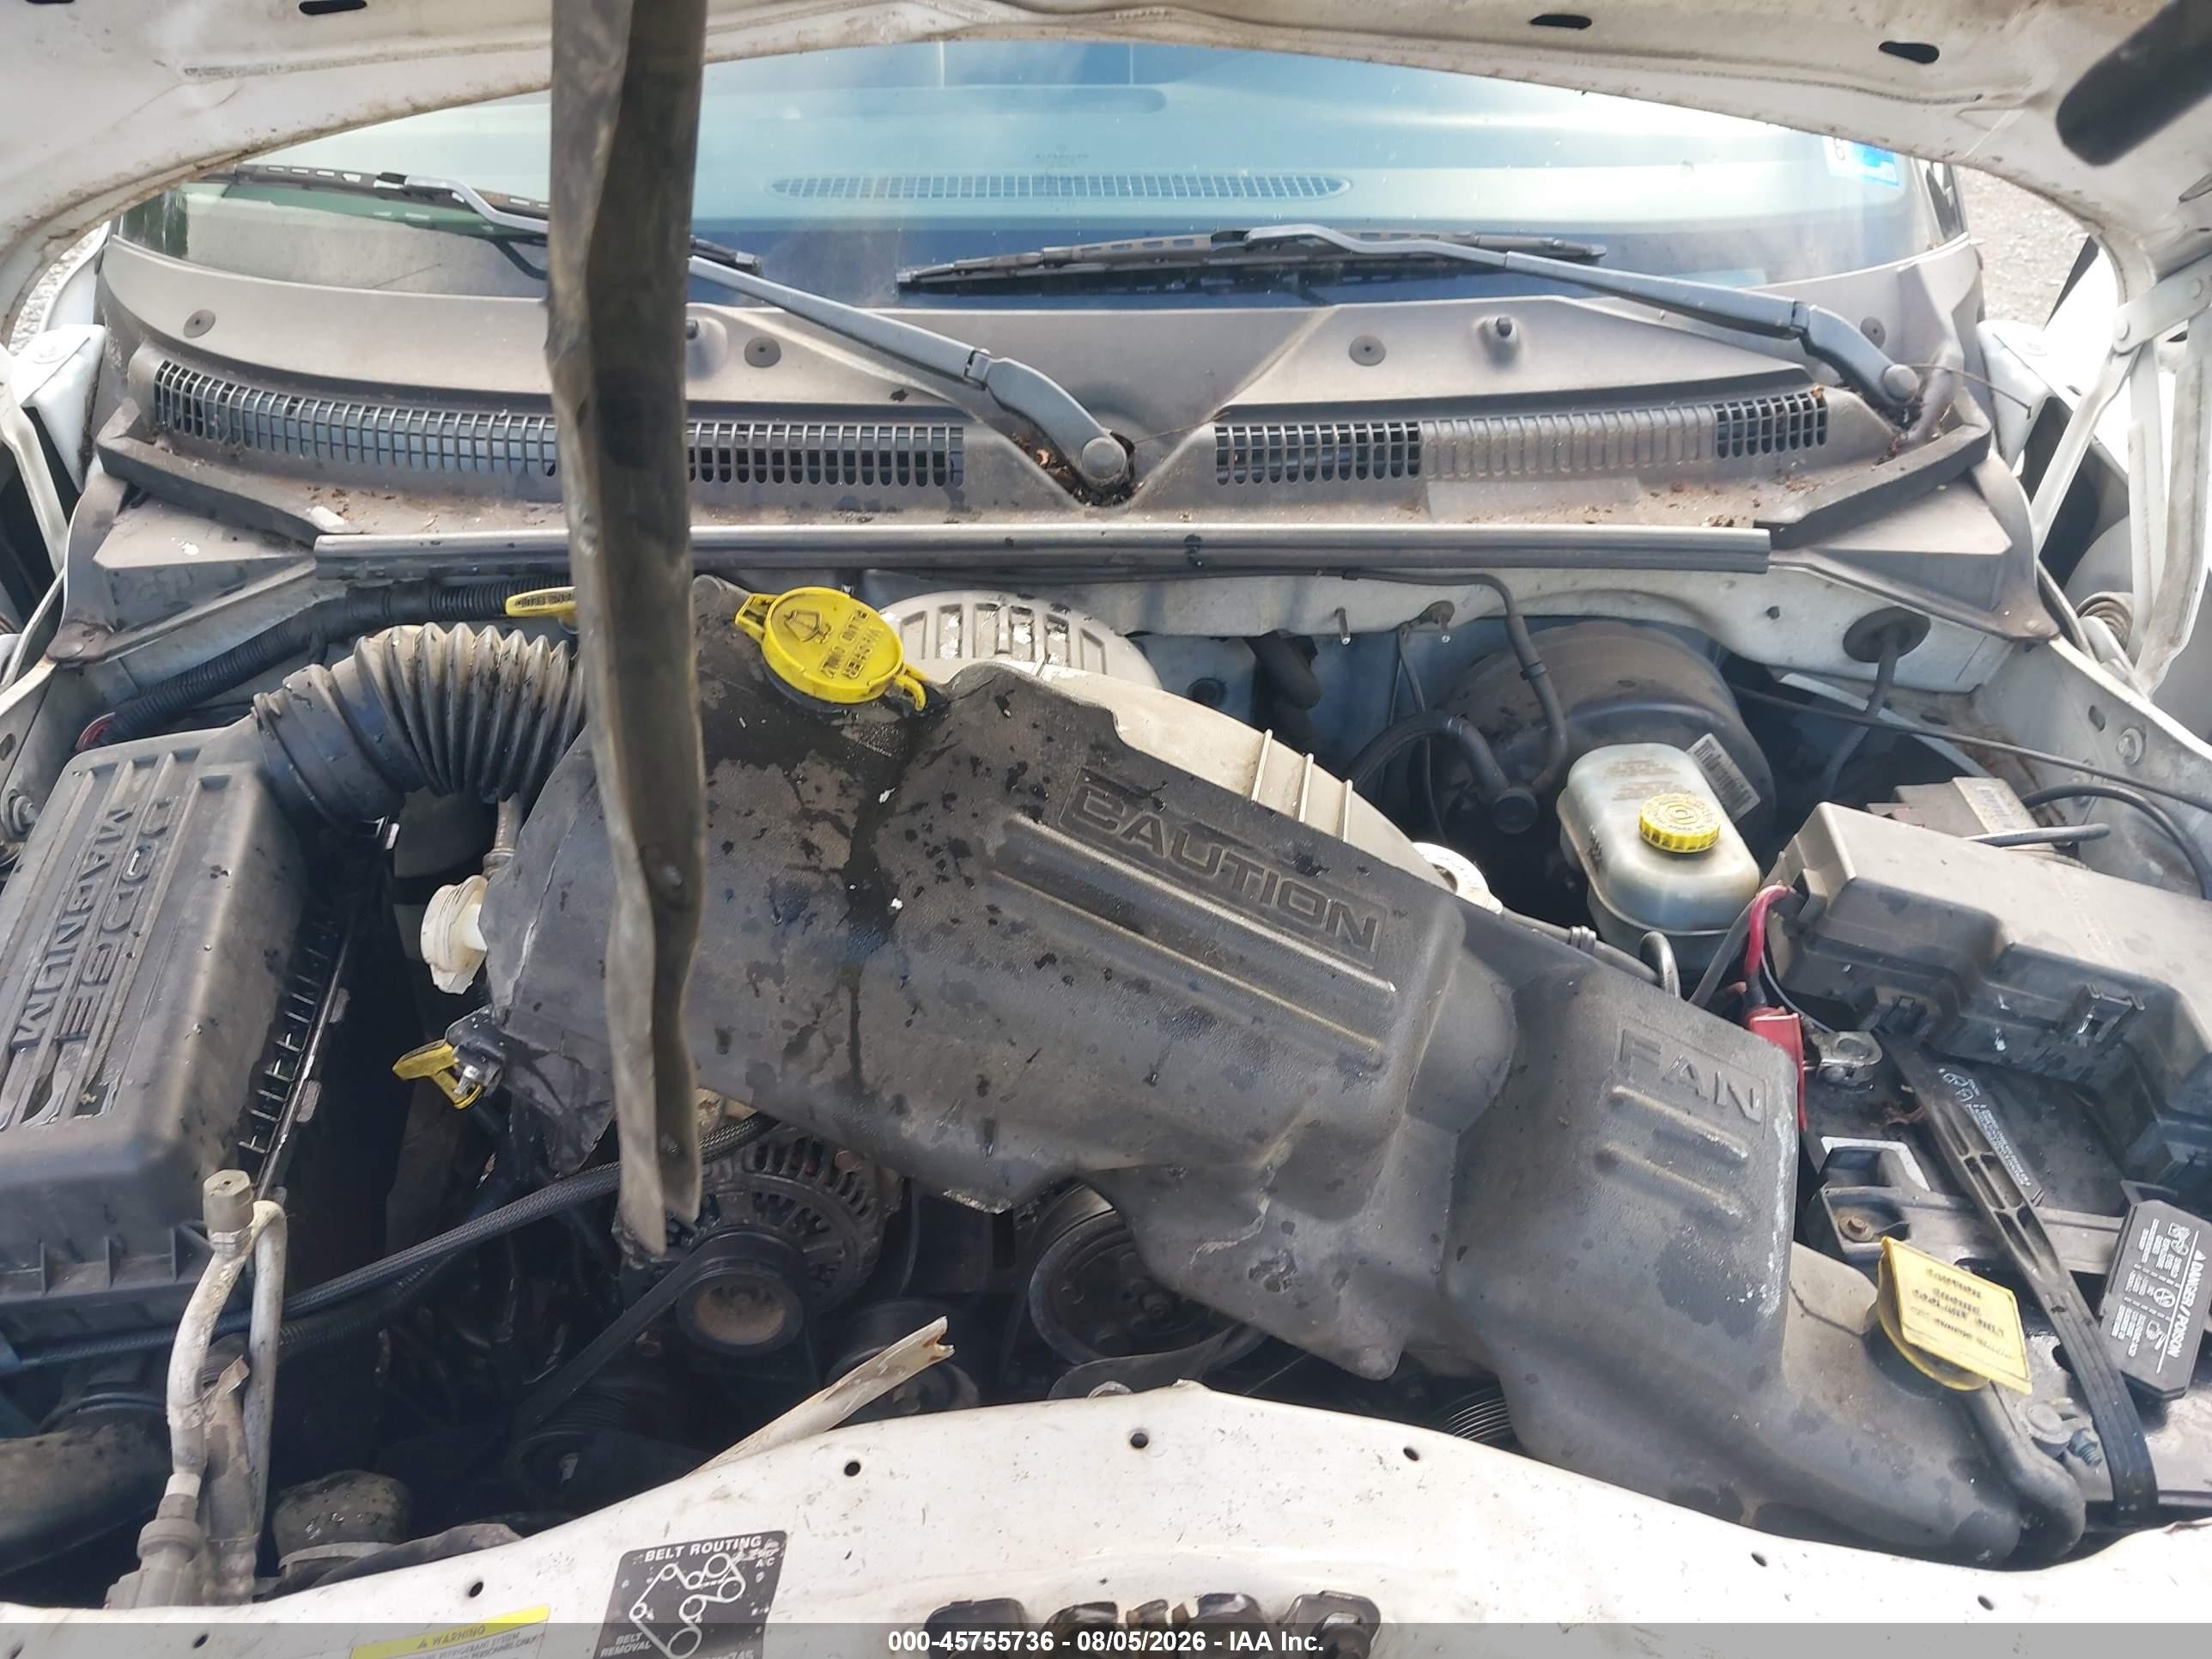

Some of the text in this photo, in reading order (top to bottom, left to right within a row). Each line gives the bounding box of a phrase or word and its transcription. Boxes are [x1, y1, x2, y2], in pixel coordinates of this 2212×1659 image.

[818, 607, 870, 679] FLUID ONLY
[842, 625, 884, 680] WASHER
[1063, 780, 1380, 953] CAUTION
[9, 808, 133, 1049] MAGNUM
[55, 799, 179, 1044] DODGE
[1619, 1028, 1764, 1125] FAN
[644, 1535, 763, 1563] BELT ROUTING
[432, 1625, 487, 1647] WARNING
[600, 1642, 652, 1658] REMOVAL
[616, 1632, 642, 1646] BELT
